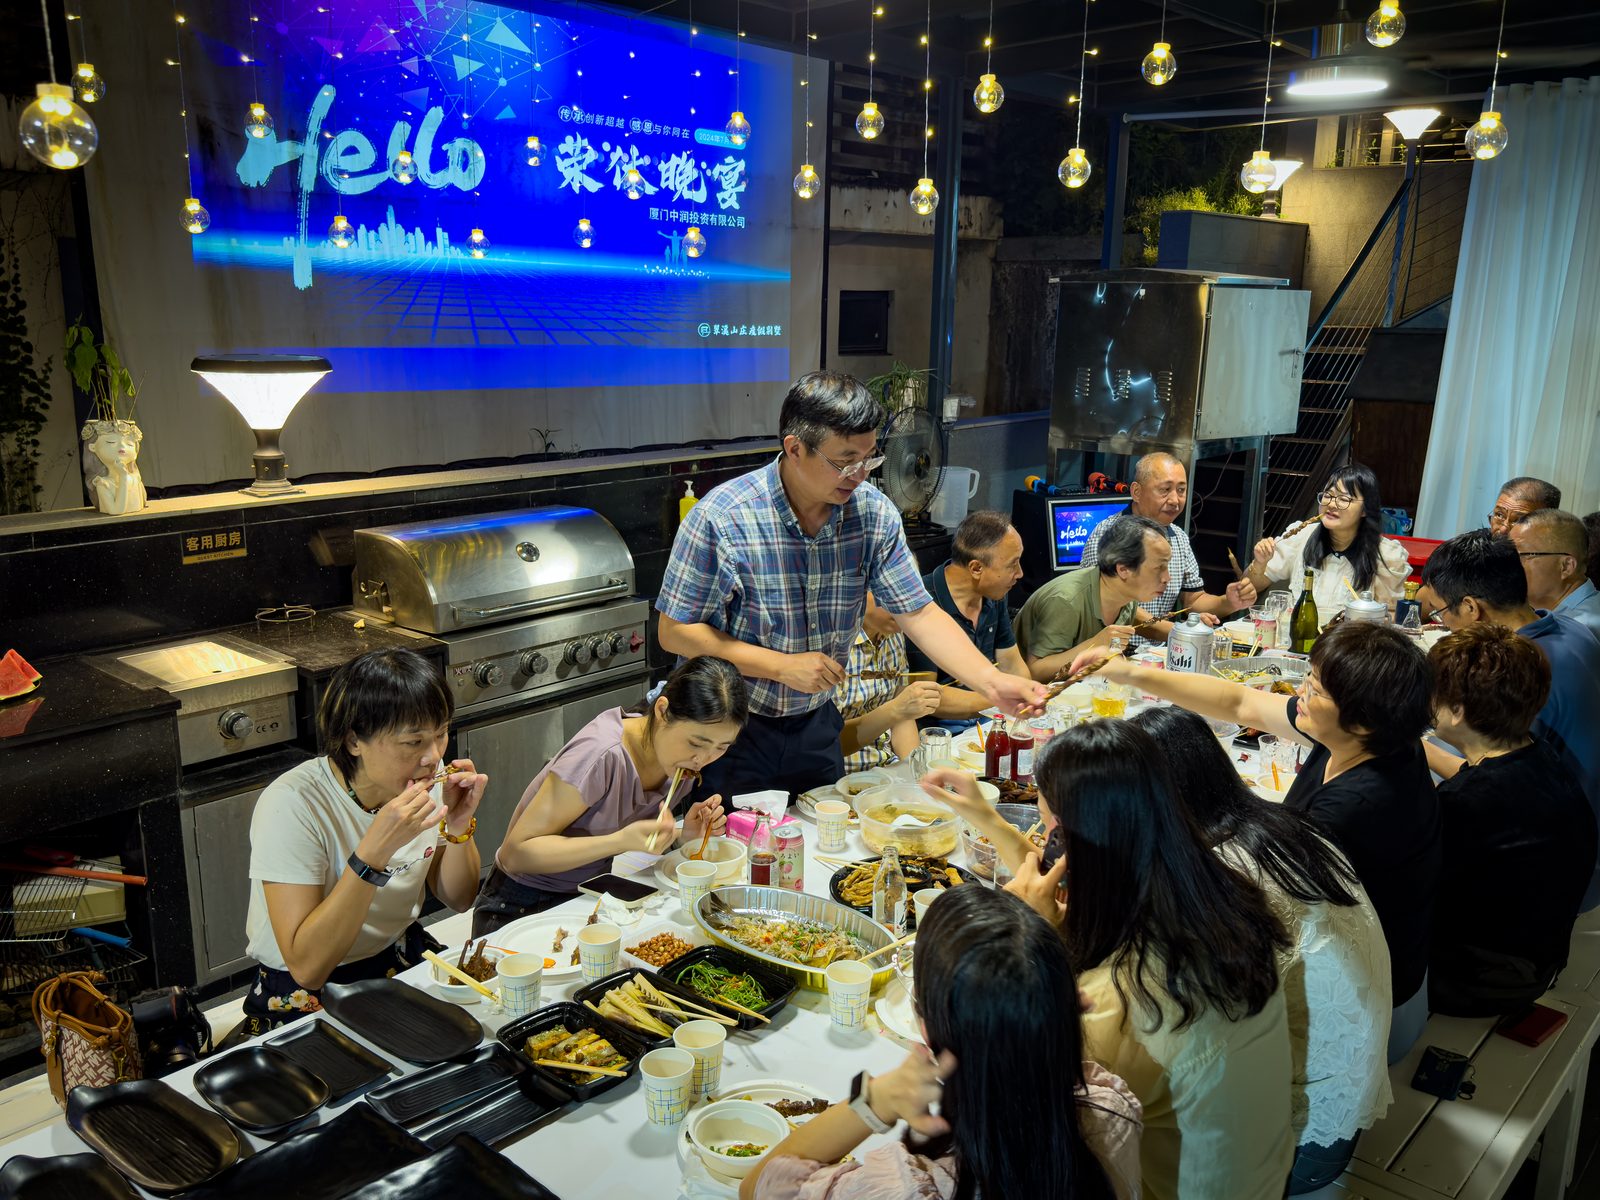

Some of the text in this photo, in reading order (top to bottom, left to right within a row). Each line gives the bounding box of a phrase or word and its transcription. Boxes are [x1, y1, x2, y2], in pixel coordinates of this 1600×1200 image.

[558, 105, 690, 139] 传承创新超越 感恩与你同在
[236, 84, 486, 290] Hello
[649, 207, 746, 229] 厦门中润投资有限公司
[186, 531, 242, 552] 客用厨房
[1060, 525, 1088, 550] Hello
